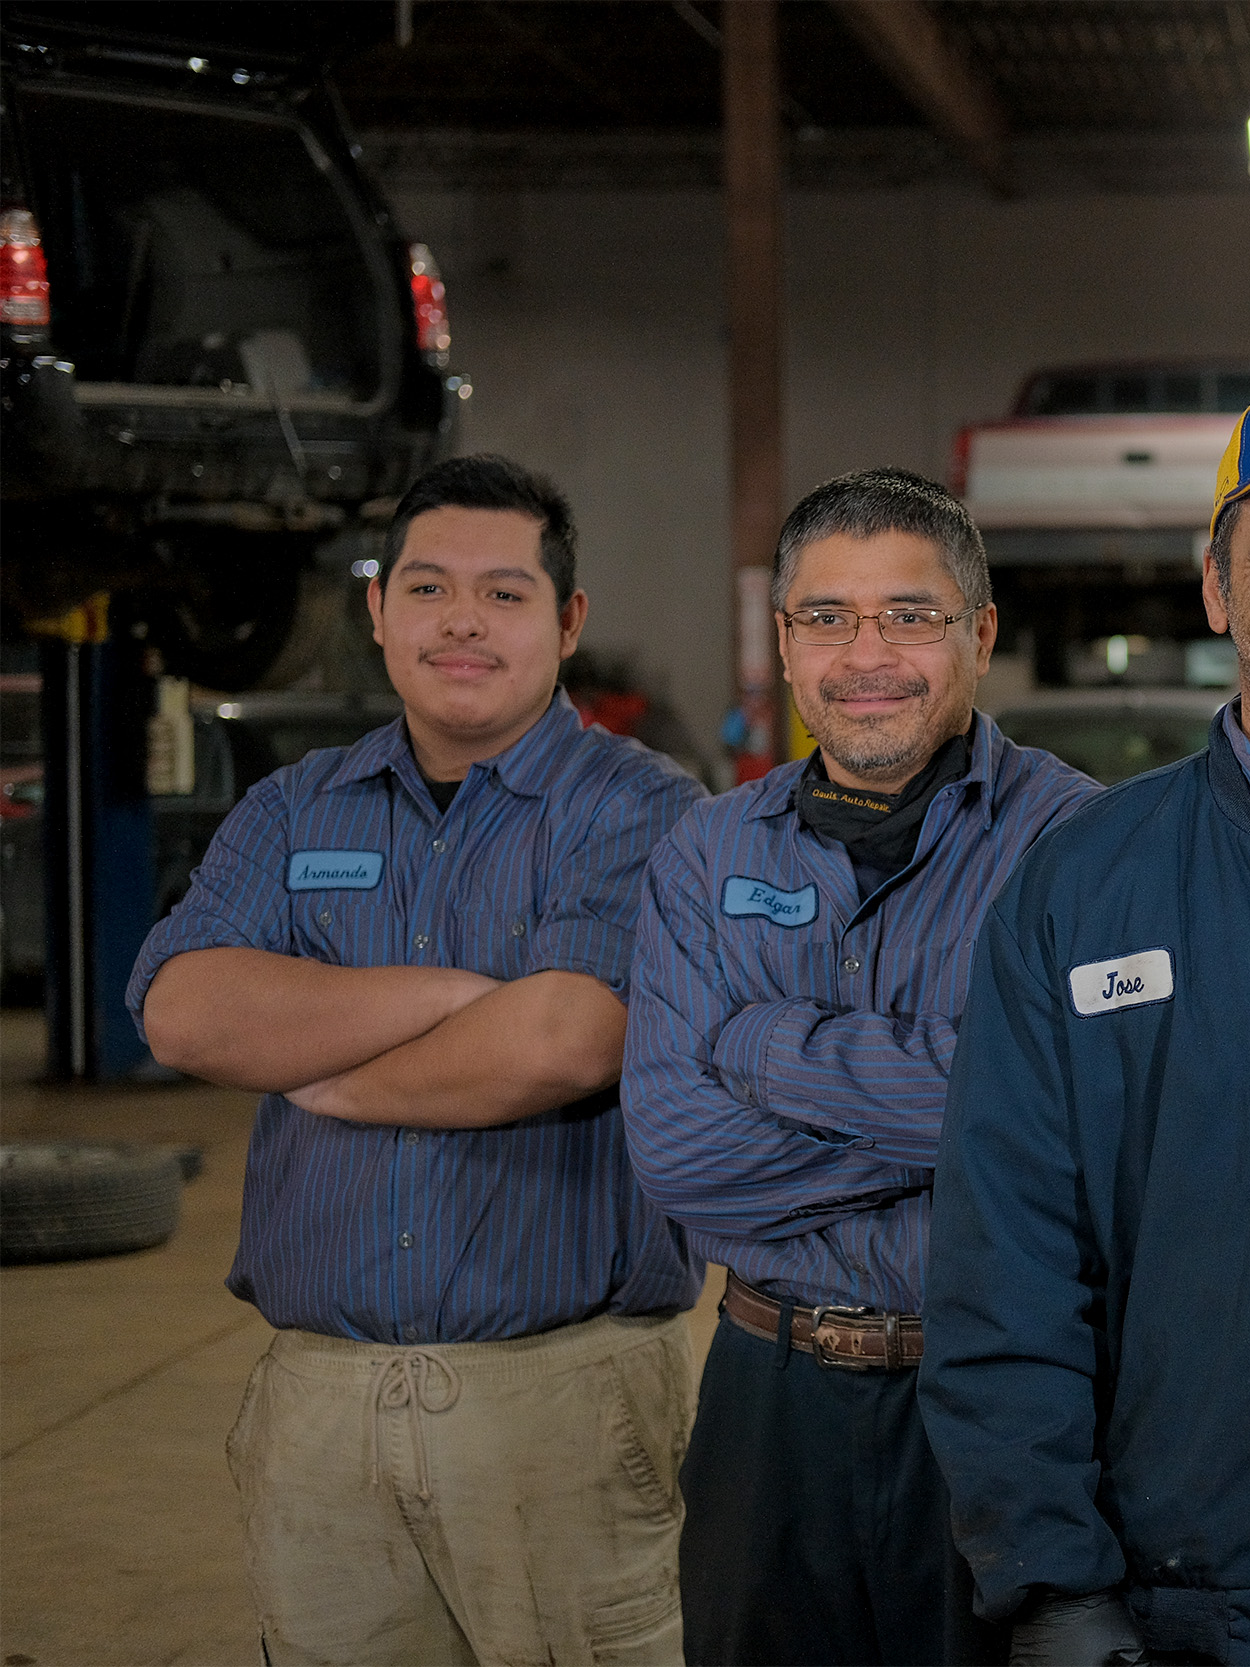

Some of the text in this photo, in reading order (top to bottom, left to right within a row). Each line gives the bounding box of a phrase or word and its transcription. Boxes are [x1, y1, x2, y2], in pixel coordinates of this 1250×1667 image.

[840, 794, 864, 807] Auto
[297, 864, 368, 881] Armando
[746, 887, 801, 916] Edgar
[1102, 970, 1145, 1000] Jose
